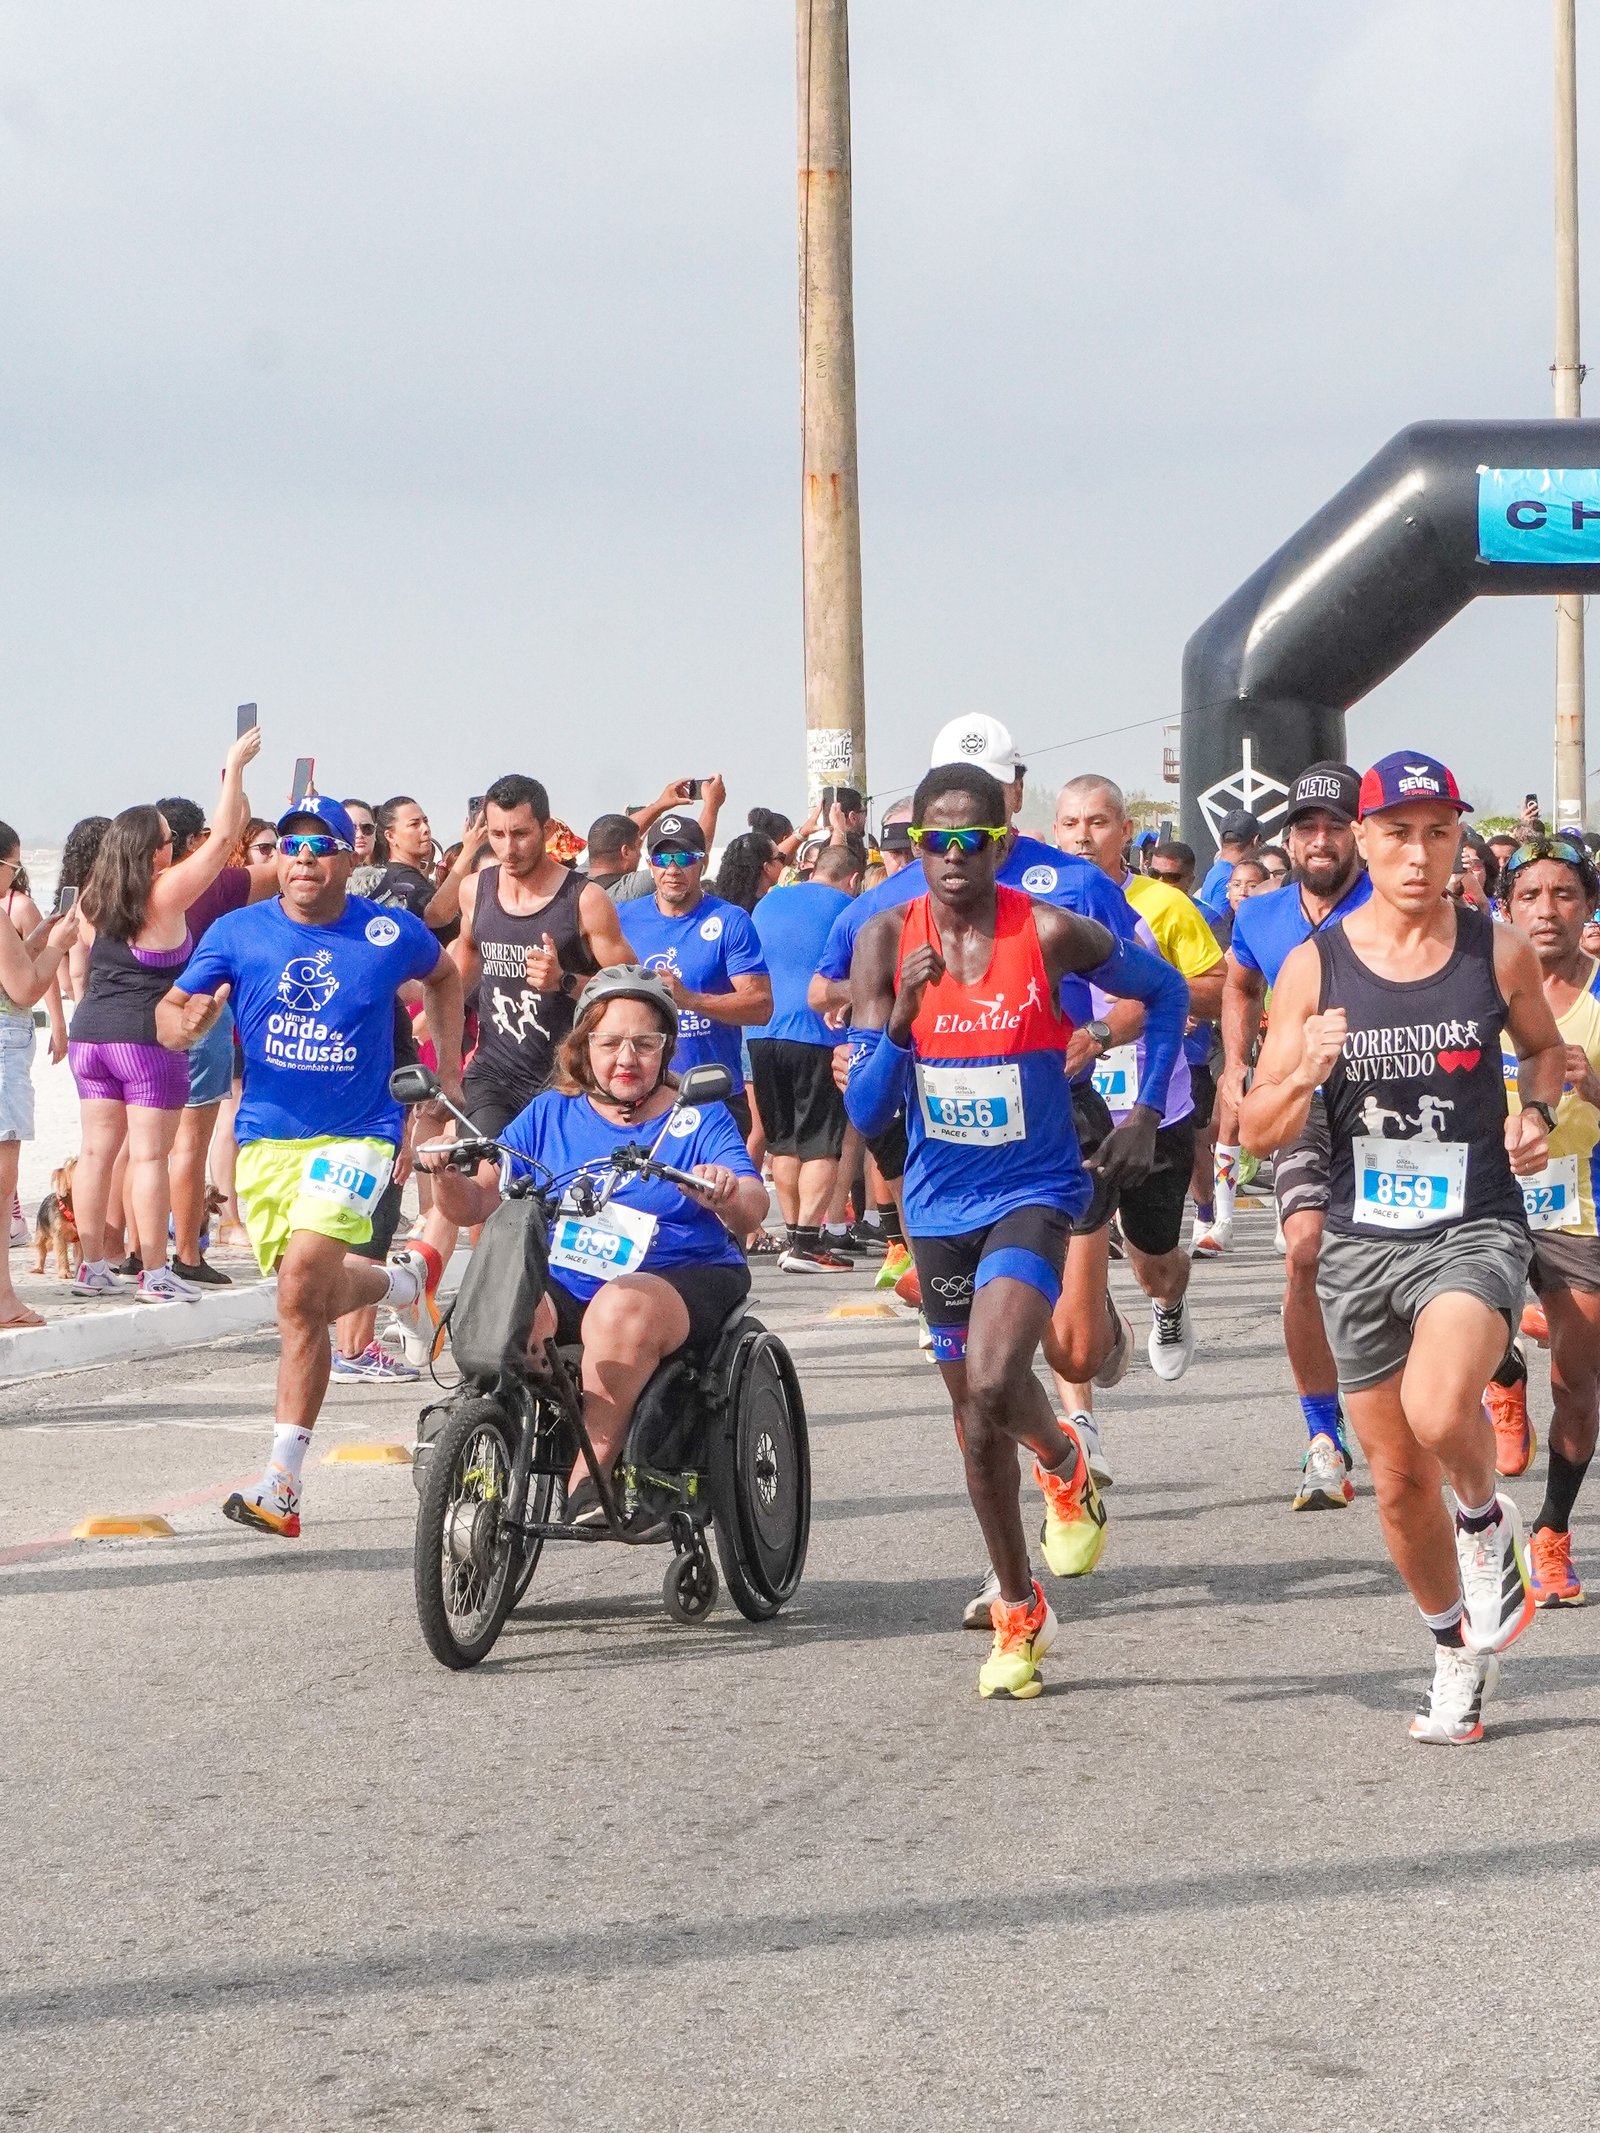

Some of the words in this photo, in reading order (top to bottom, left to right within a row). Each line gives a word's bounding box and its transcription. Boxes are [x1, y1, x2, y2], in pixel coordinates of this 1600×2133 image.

[1398, 776, 1439, 793] SEVEN
[268, 1014, 328, 1040] Onda
[329, 1030, 343, 1040] de
[284, 1012, 306, 1023] Uma
[933, 1010, 1020, 1033] EloAtle
[265, 1034, 357, 1063] Inclusão
[1342, 1022, 1450, 1060] CORRENDO
[266, 1055, 287, 1068] Juntos
[287, 1062, 297, 1070] no
[297, 1063, 329, 1072] combate
[940, 1098, 994, 1127] 856
[941, 1128, 961, 1138] PACE
[324, 1160, 366, 1193] 301
[1377, 1173, 1433, 1208] 859
[1373, 1208, 1393, 1218] PACE
[1393, 1211, 1399, 1219] 6
[574, 1226, 621, 1260] 899
[564, 1253, 582, 1265] PACE
[582, 1257, 588, 1265] 6
